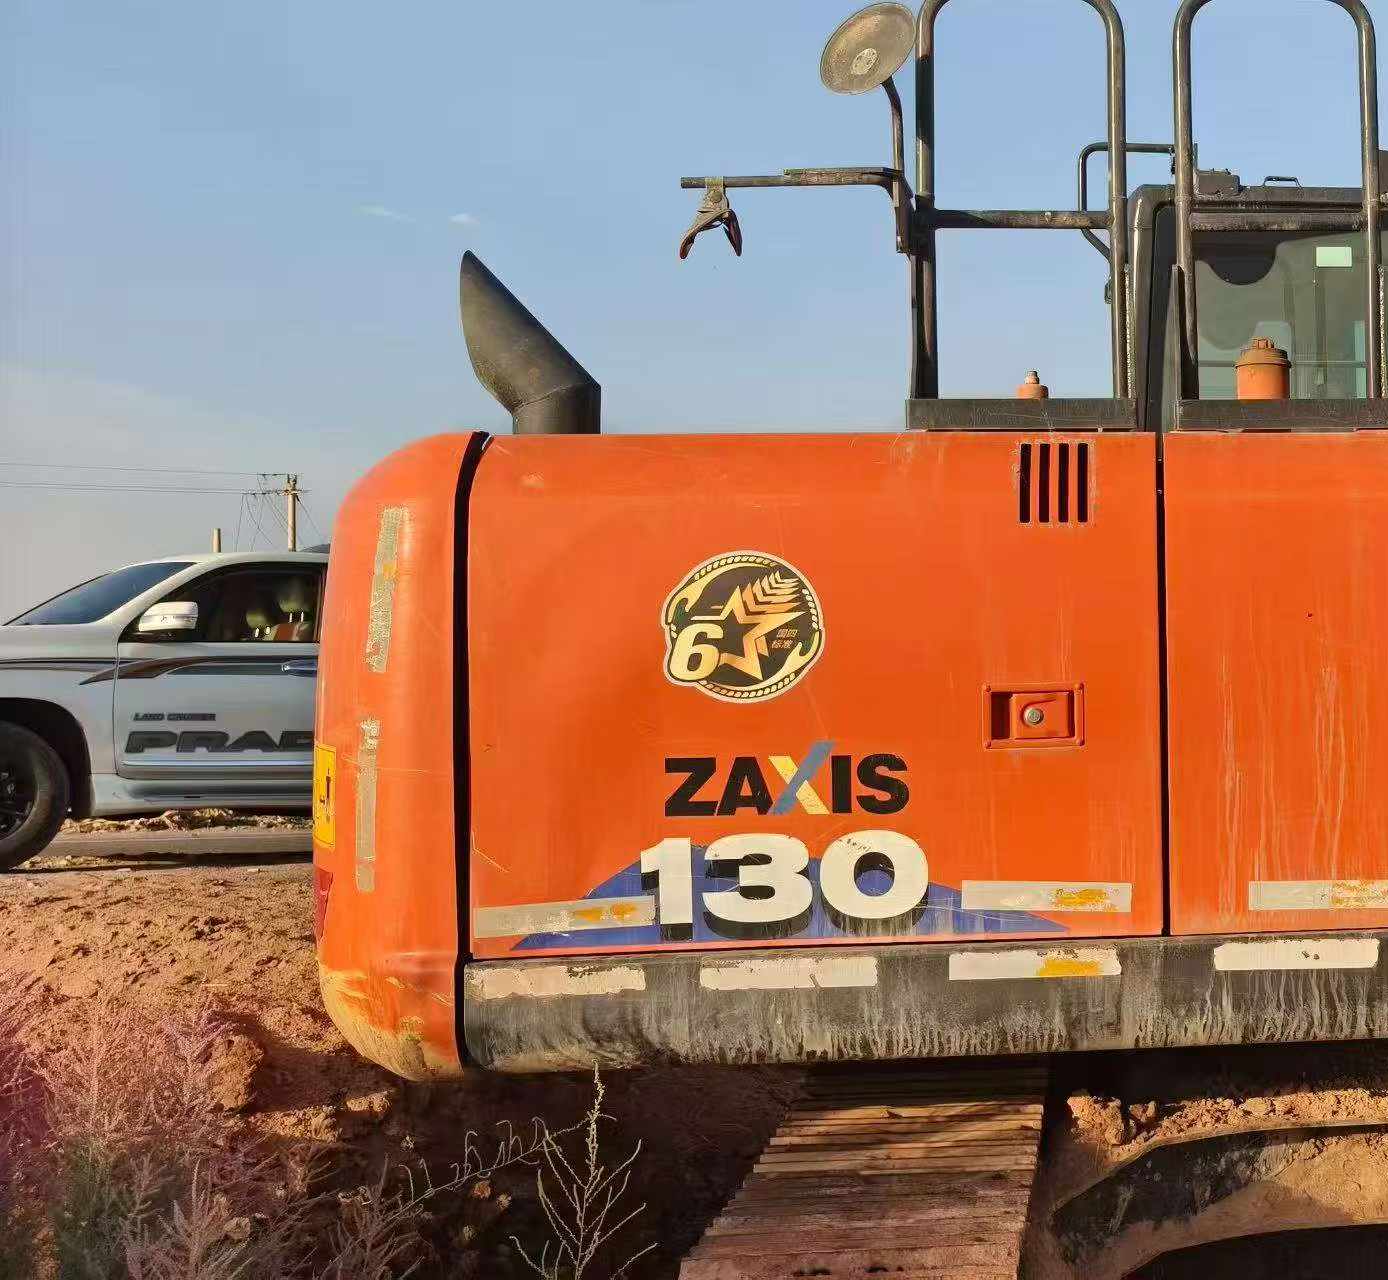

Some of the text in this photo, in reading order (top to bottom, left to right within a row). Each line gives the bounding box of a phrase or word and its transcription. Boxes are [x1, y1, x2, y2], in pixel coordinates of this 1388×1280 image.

[671, 623, 724, 680] 6
[167, 712, 216, 721] CRUR
[665, 741, 909, 817] ZAXIS
[640, 829, 929, 928] 130
